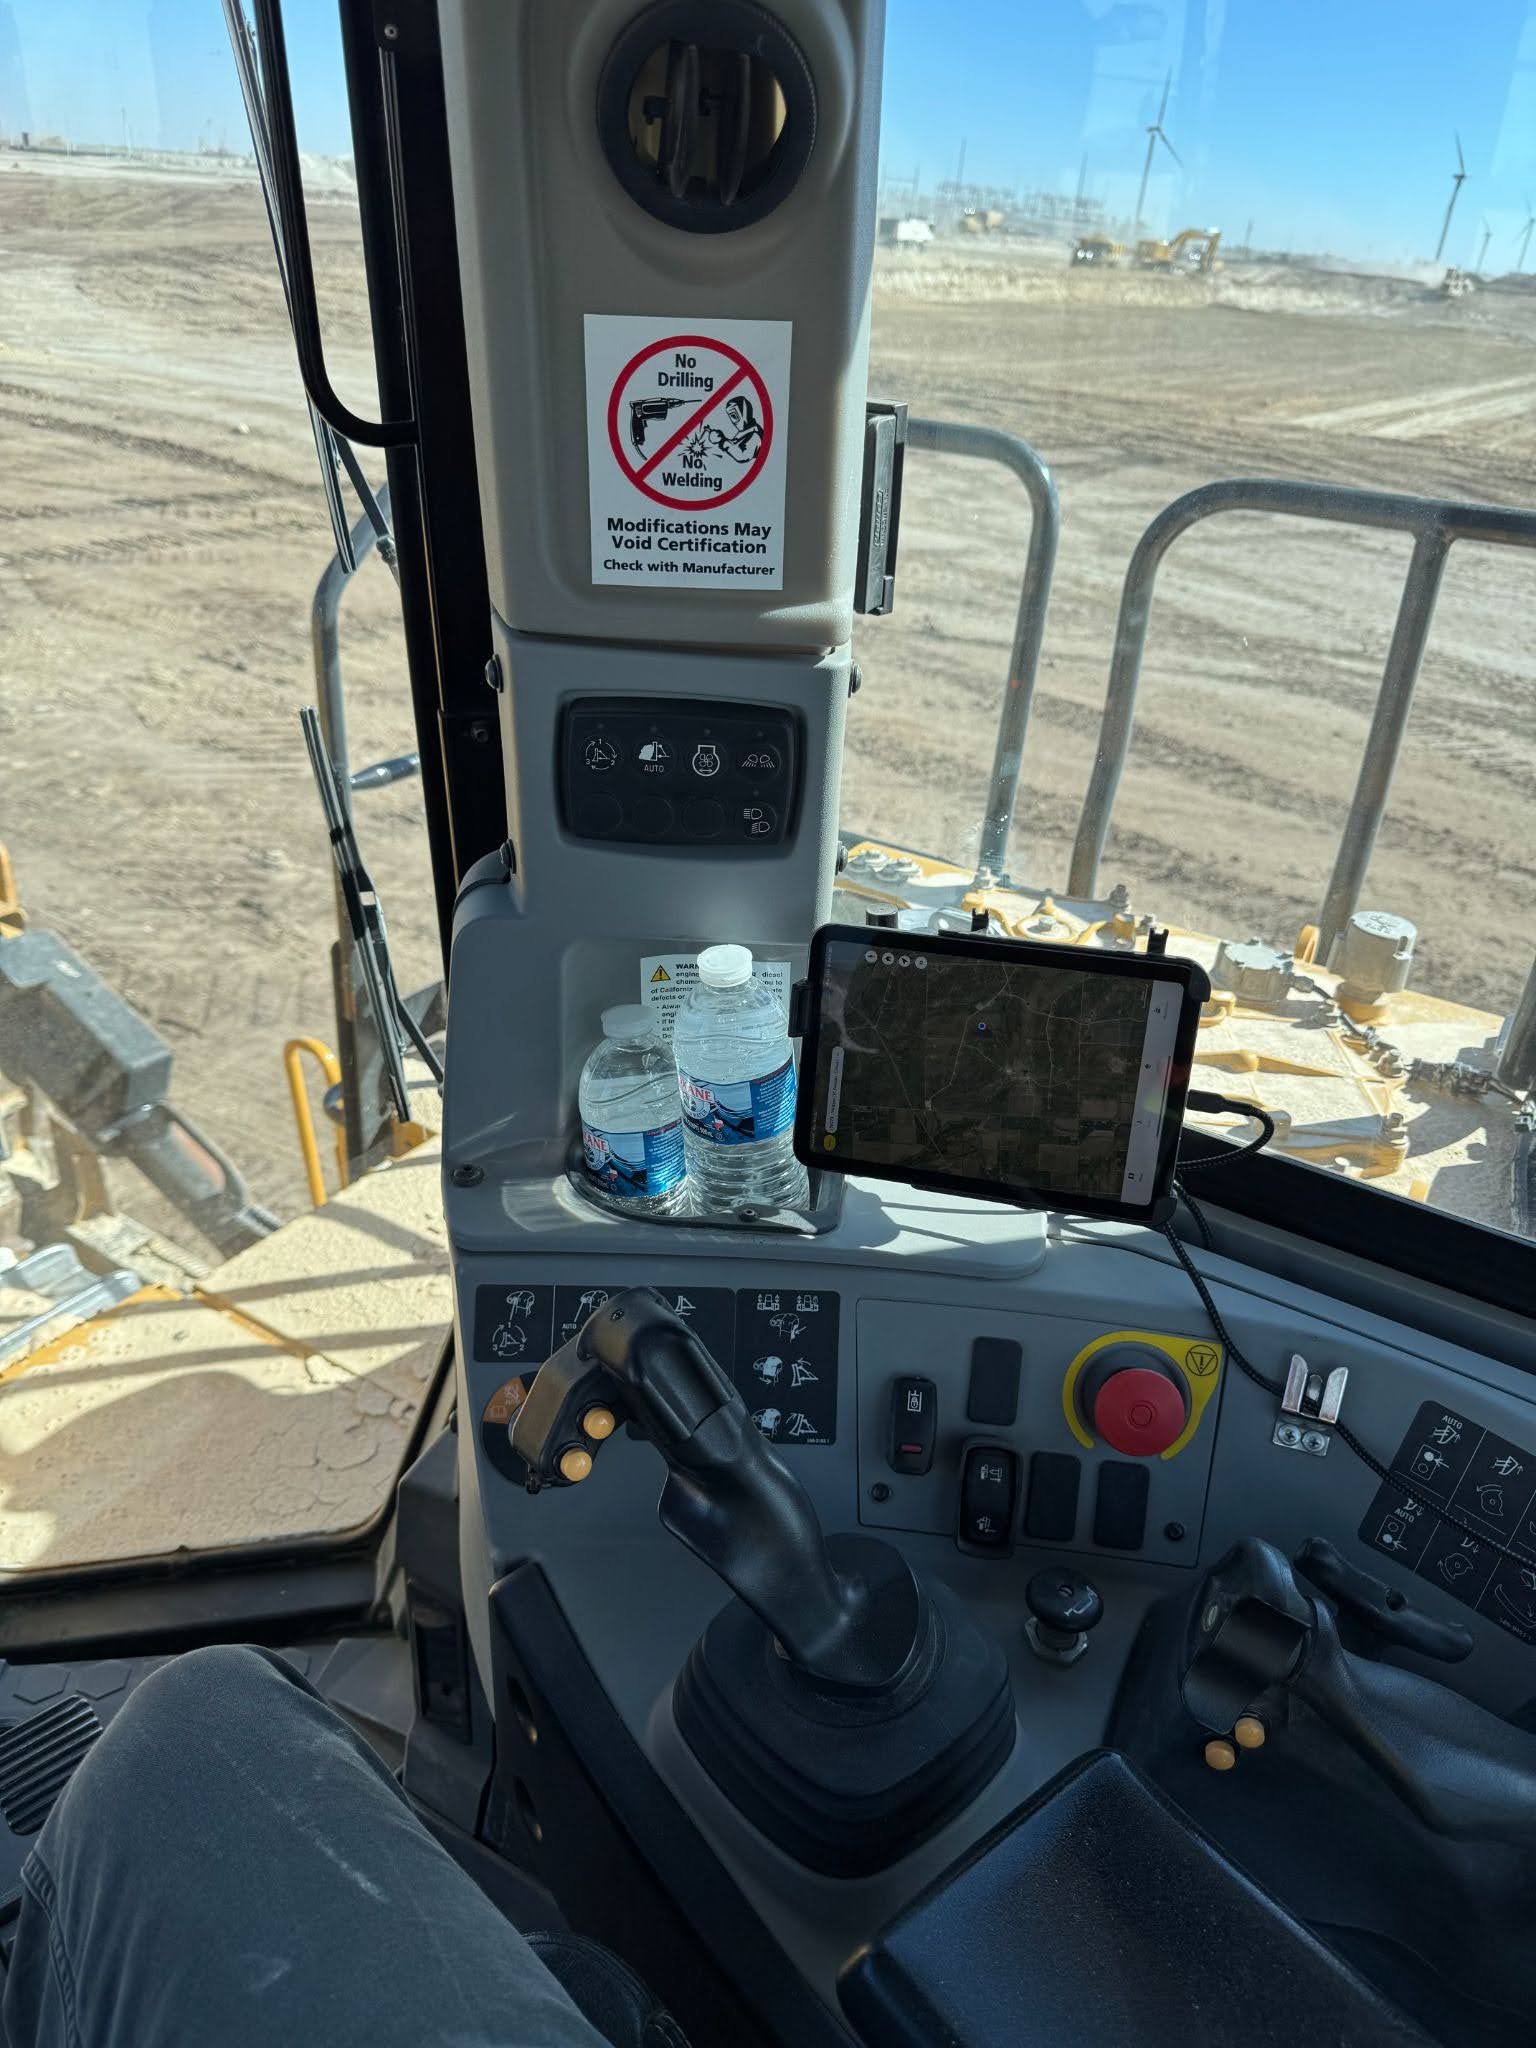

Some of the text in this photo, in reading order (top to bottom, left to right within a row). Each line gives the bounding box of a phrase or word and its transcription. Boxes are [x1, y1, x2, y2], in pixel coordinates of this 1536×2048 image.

[675, 354, 696, 368] No
[658, 372, 714, 391] Drilling
[682, 455, 703, 469] No
[662, 472, 723, 491] Welding
[607, 517, 772, 539] Modifications May
[612, 535, 767, 554] Void Certification
[603, 559, 775, 576] Check with Manufacturer
[644, 764, 664, 772] AUTO
[1441, 1415, 1463, 1430] AUTO
[1394, 1508, 1415, 1523] AUTO
